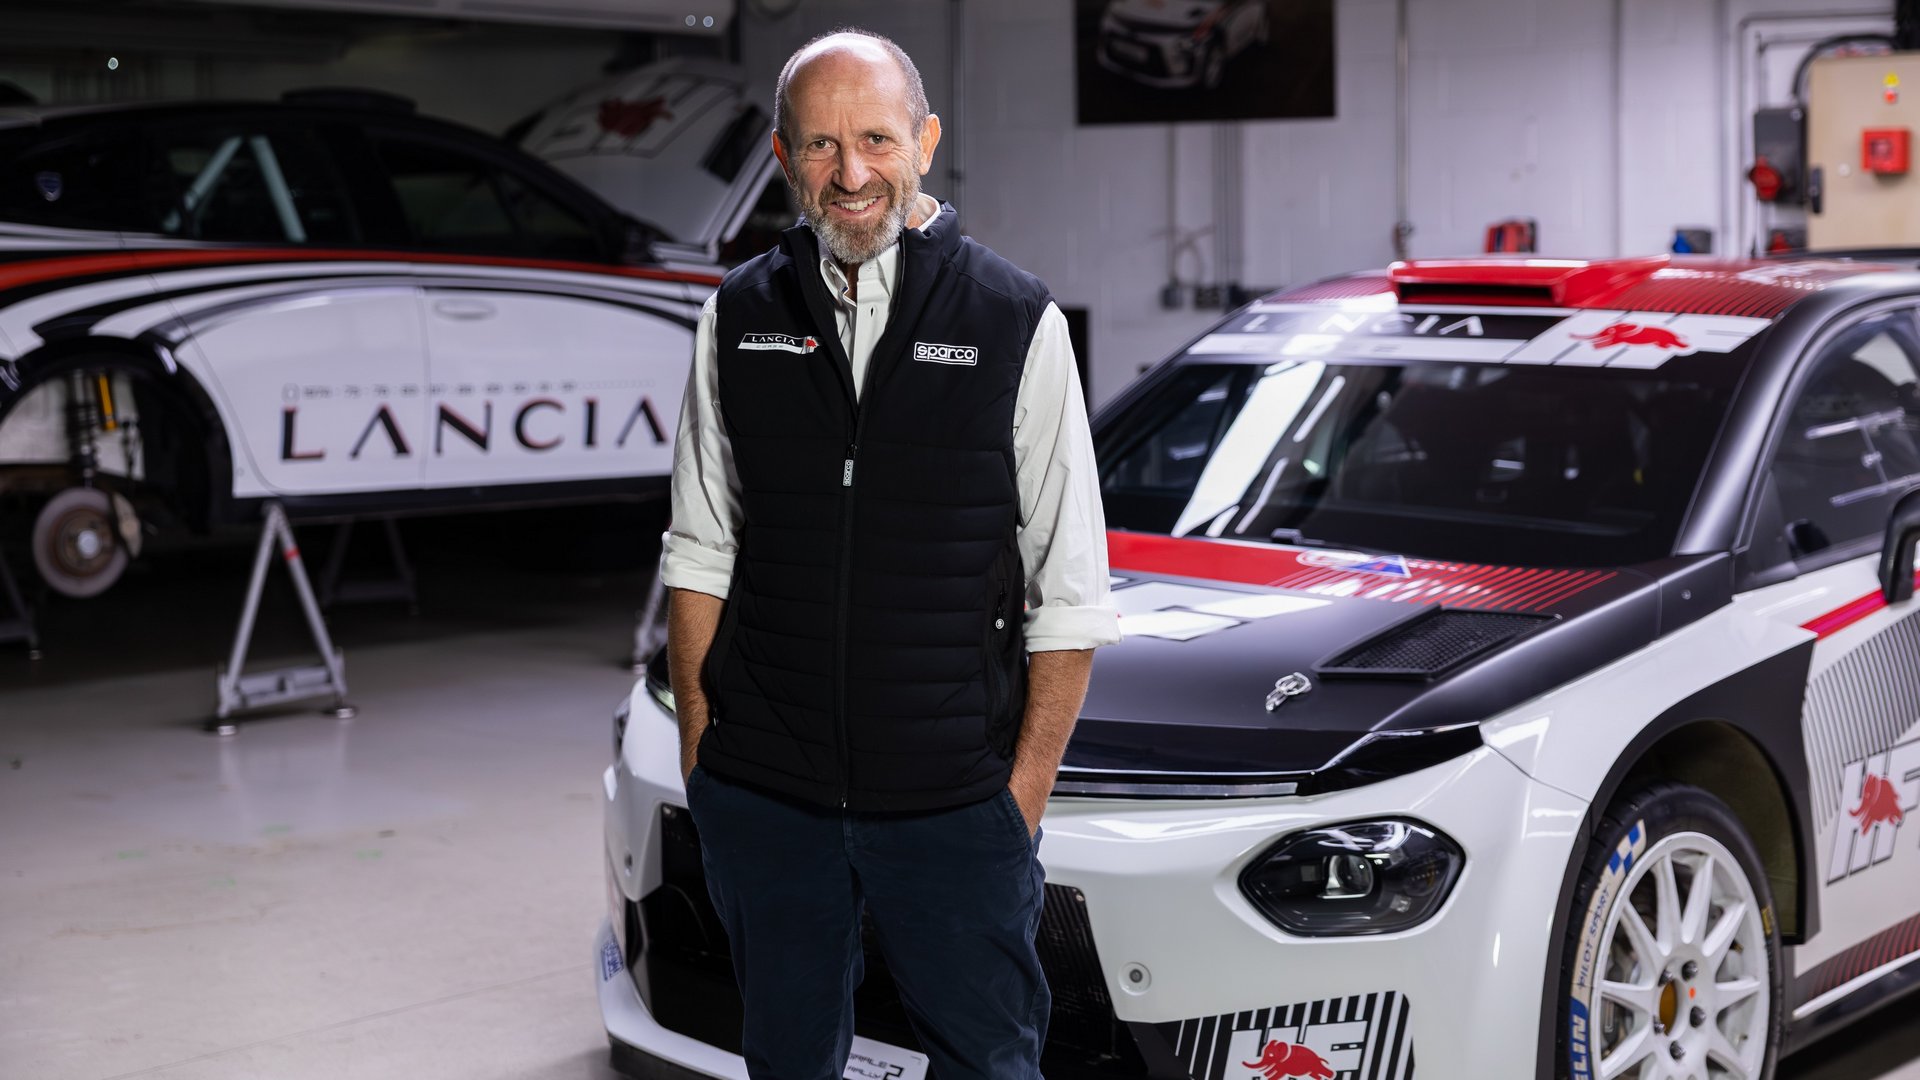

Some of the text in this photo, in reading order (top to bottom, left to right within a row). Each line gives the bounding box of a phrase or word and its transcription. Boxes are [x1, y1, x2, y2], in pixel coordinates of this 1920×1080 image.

[752, 335, 796, 345] LANCIA
[917, 345, 975, 360] sparco
[281, 396, 668, 462] LANCIA
[1577, 939, 1593, 989] PILOT
